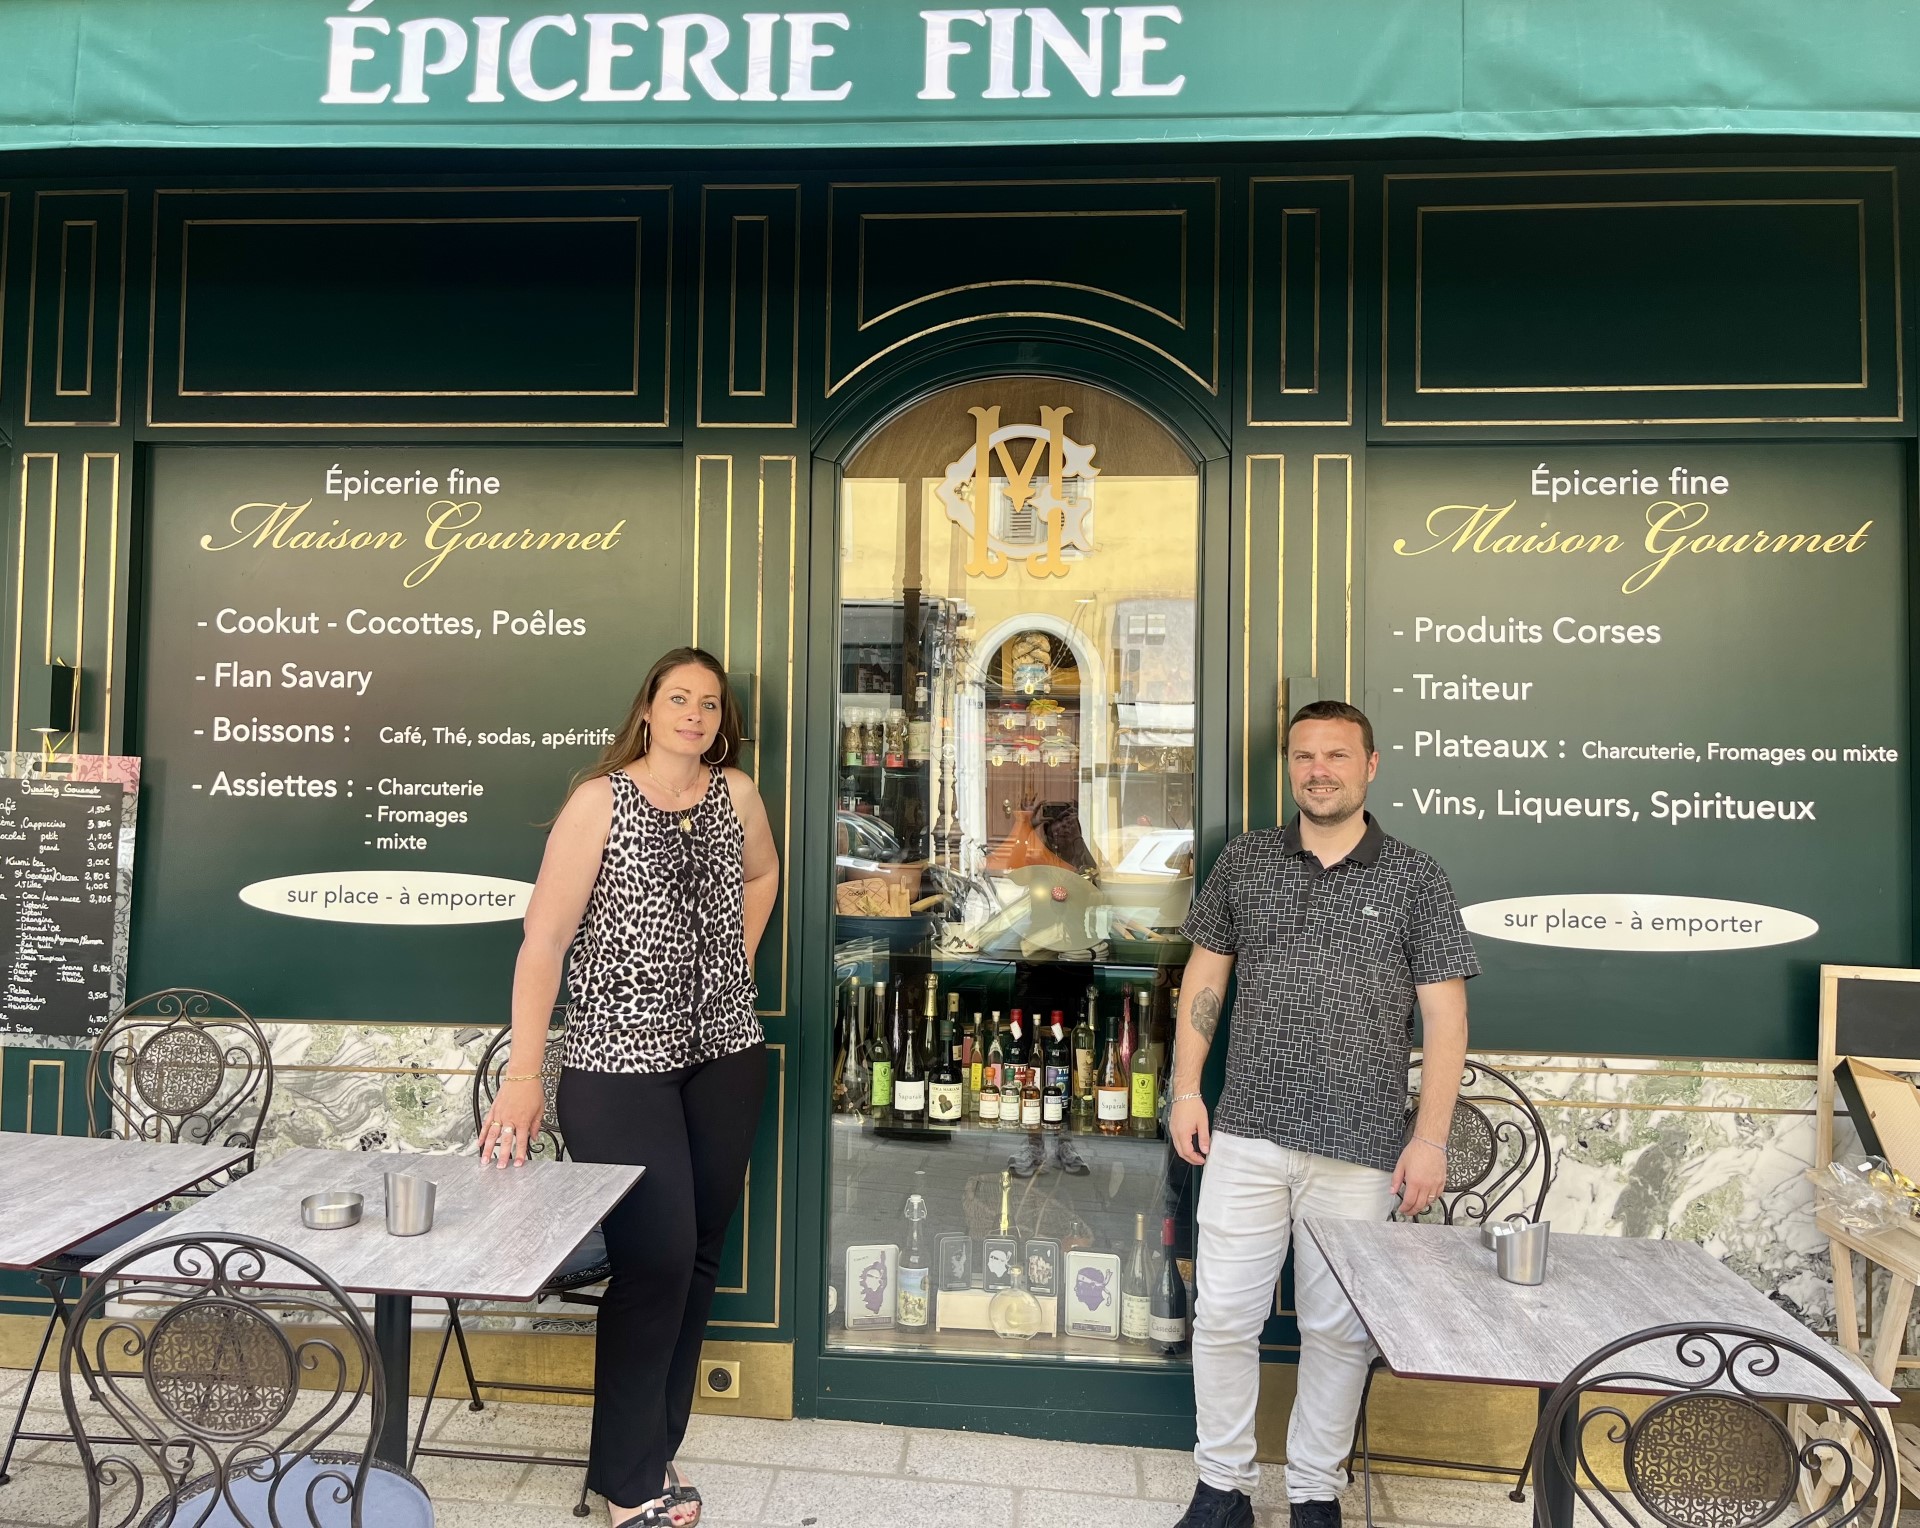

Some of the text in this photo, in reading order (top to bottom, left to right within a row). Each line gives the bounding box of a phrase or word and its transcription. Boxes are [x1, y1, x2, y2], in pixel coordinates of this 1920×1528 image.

[320, 0, 1186, 103] ÉPICERIE FINE
[326, 464, 501, 500] Épicerie fine
[1530, 463, 1730, 502] Épicerie fine
[200, 498, 628, 588] Maison Gourmet
[1393, 499, 1874, 594] Maison Gourmet
[216, 607, 320, 634] Cookut
[346, 609, 482, 639] Cocottes,
[492, 609, 587, 636] Poêles
[1415, 615, 1543, 644] Produits
[1552, 616, 1661, 644] Corses
[215, 661, 272, 688] Flan
[280, 662, 373, 696] Savary
[1412, 673, 1533, 701] Traiteur
[213, 716, 335, 743] Boissons
[379, 726, 427, 746] Café,
[431, 727, 473, 747] Thé,
[477, 727, 536, 748] sodas,
[1415, 729, 1549, 759] Plateaux
[1581, 740, 1701, 763] Charcuterie,
[1707, 742, 1806, 766] Fromages
[1811, 748, 1837, 762] ou
[1843, 743, 1899, 763] mixte
[209, 771, 338, 798] Assiettes
[377, 778, 484, 797] Charcuterie
[377, 806, 468, 827] Fromages
[1411, 788, 1486, 820] Vins,
[1497, 789, 1640, 824] Liqueurs,
[1650, 790, 1817, 826] Spiritueux
[40, 831, 58, 842] petit
[376, 832, 428, 850] mixte
[286, 889, 318, 904] sur
[323, 885, 379, 908] place
[399, 886, 410, 905] à
[417, 889, 516, 911] emporter
[1503, 911, 1539, 928] sur
[1545, 907, 1607, 932] place
[1630, 910, 1643, 931] à
[1651, 913, 1763, 938] emporter
